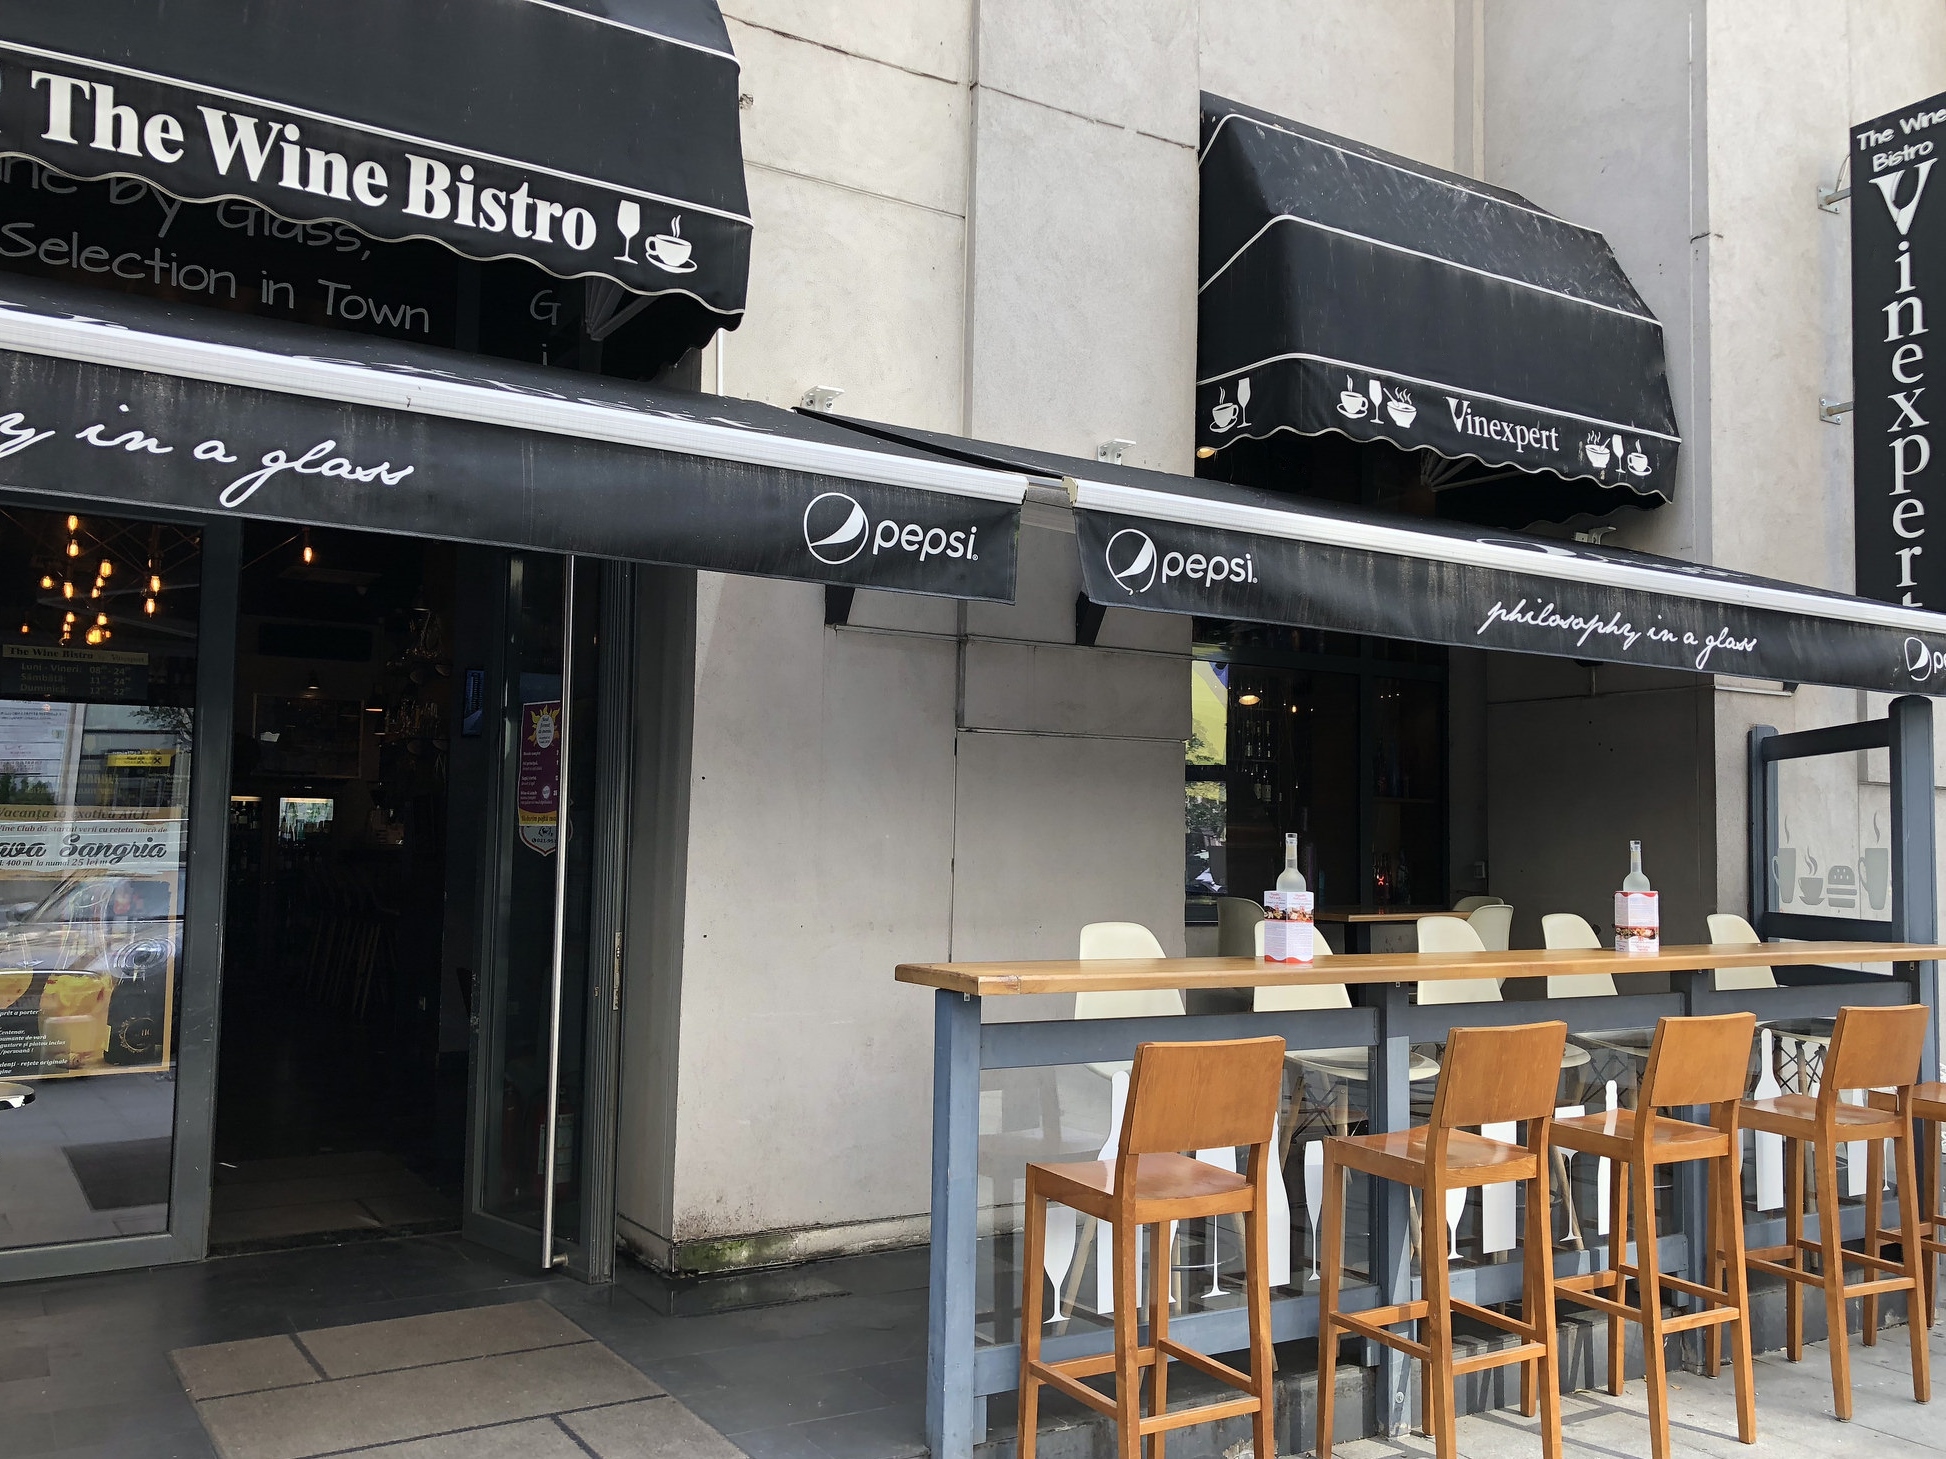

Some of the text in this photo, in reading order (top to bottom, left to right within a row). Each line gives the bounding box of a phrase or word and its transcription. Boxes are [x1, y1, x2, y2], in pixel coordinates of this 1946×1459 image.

[1857, 109, 1946, 151] The Wine
[32, 71, 597, 250] The Wine Bistro
[1872, 140, 1934, 173] Bistro
[0, 222, 429, 333] Selection in Town
[1444, 396, 1560, 453] Vinexpert
[75, 404, 174, 454] in
[193, 440, 238, 463] a
[219, 440, 415, 508] glass
[872, 519, 977, 562] pepsi
[1161, 551, 1256, 588] pepsi
[10, 647, 29, 656] The
[33, 649, 58, 657] Wine
[62, 650, 93, 659] Bistro
[1477, 598, 1758, 670] philosophy in a glass
[22, 663, 41, 671] Luni
[59, 833, 167, 866] Sangria
[71, 858, 84, 866] 25
[86, 858, 98, 866] lei
